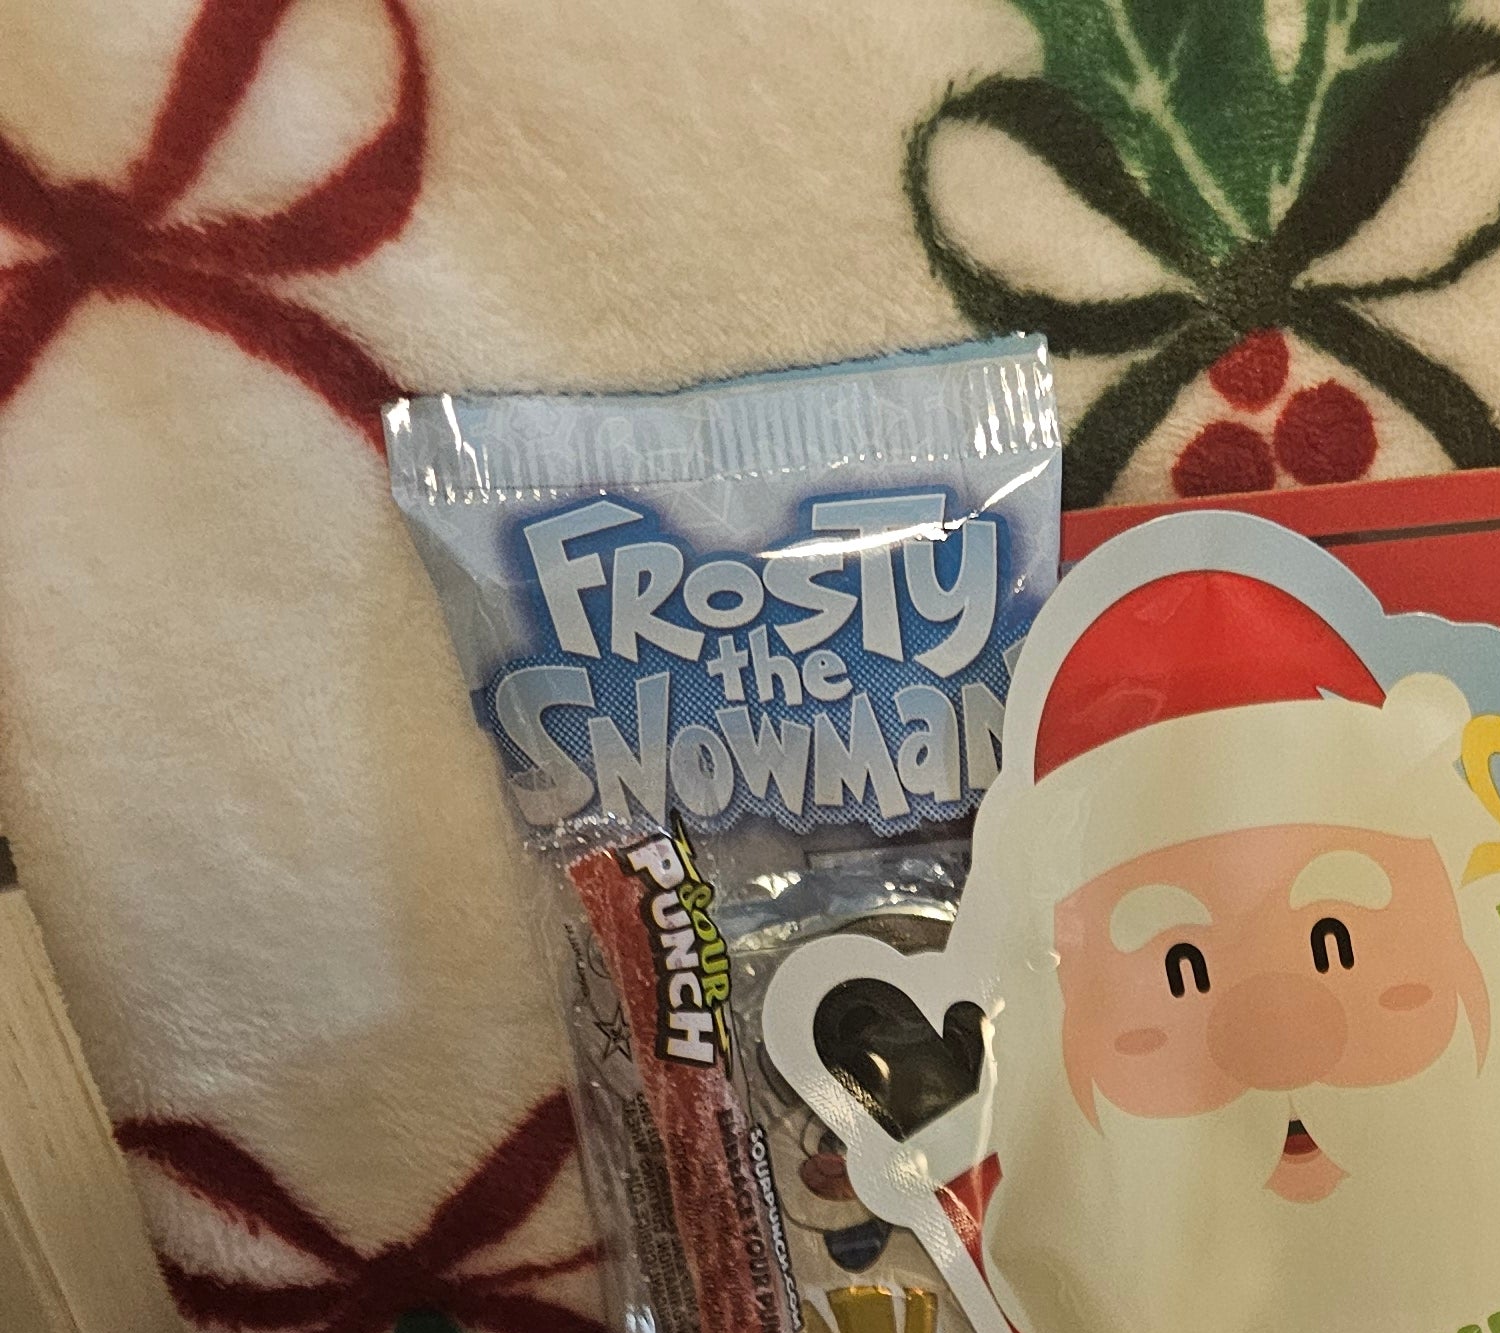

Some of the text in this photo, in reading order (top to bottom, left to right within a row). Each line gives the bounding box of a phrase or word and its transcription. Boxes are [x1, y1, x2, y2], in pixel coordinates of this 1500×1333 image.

[707, 629, 853, 705] the
[624, 836, 716, 1066] PUNCH
[680, 882, 730, 1004] SOUR
